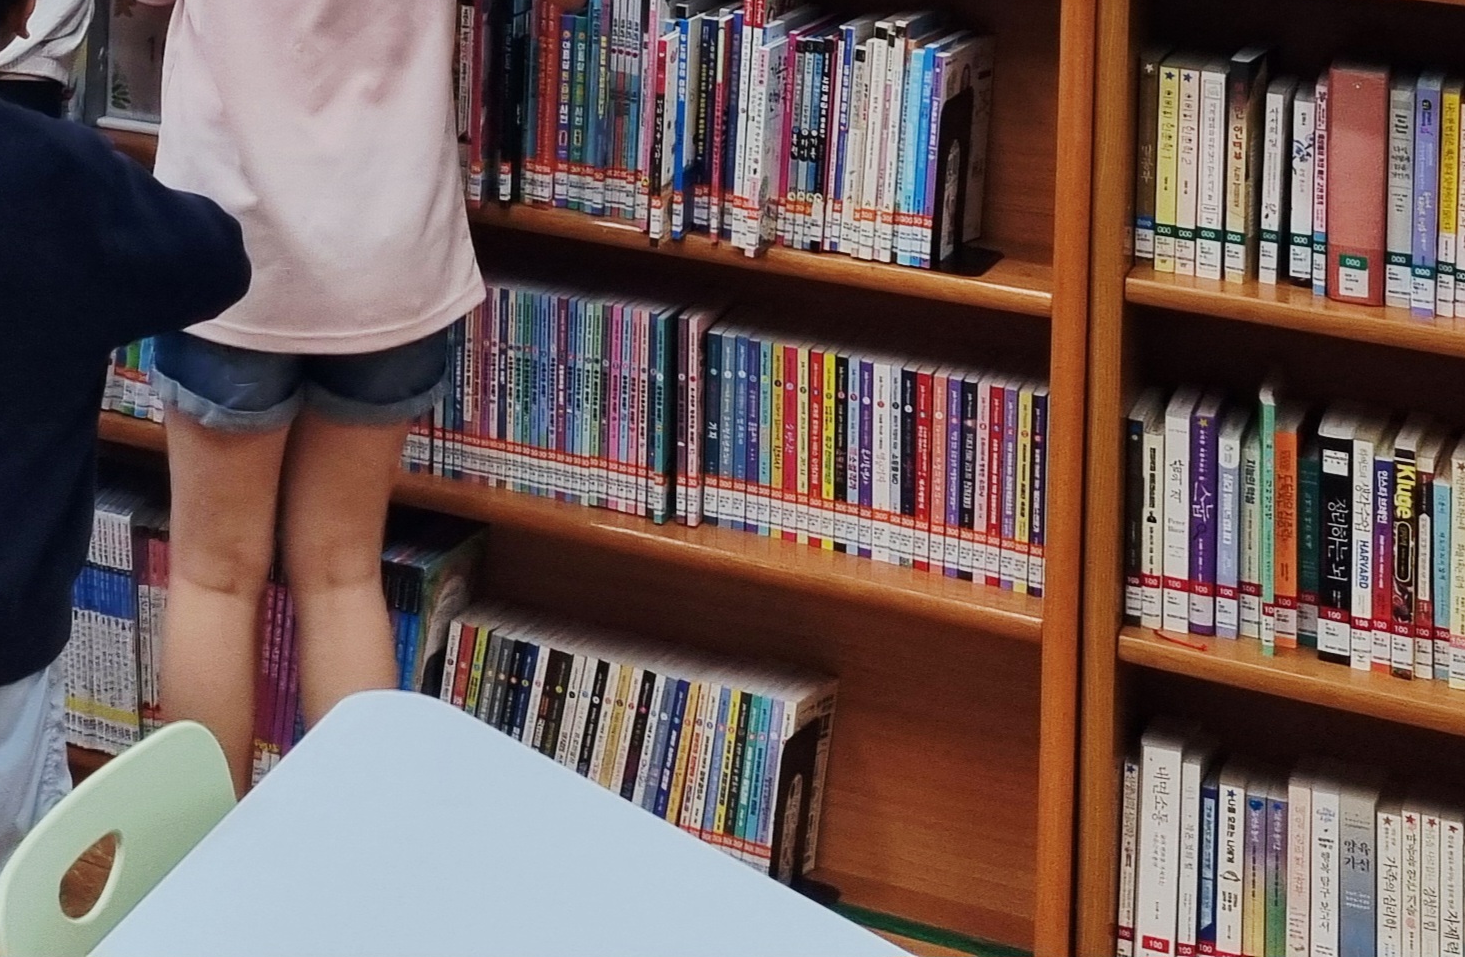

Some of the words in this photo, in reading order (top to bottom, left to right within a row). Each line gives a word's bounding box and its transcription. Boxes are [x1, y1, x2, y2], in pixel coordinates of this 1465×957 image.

[1192, 481, 1214, 523] 스눕
[1394, 463, 1417, 520] Kluge
[1327, 498, 1349, 558] 정리하는
[1327, 559, 1349, 582] 뇌
[1359, 539, 1370, 590] HARVARD
[1168, 580, 1182, 588] 100
[1220, 588, 1233, 596] 100
[1394, 625, 1408, 635] 100
[1436, 629, 1451, 638] 100
[1152, 766, 1171, 826] 내면소통
[1227, 798, 1237, 814] 나를
[1226, 815, 1236, 838] 모르는
[1225, 839, 1236, 864] 나에게
[1443, 911, 1461, 955] 자제력
